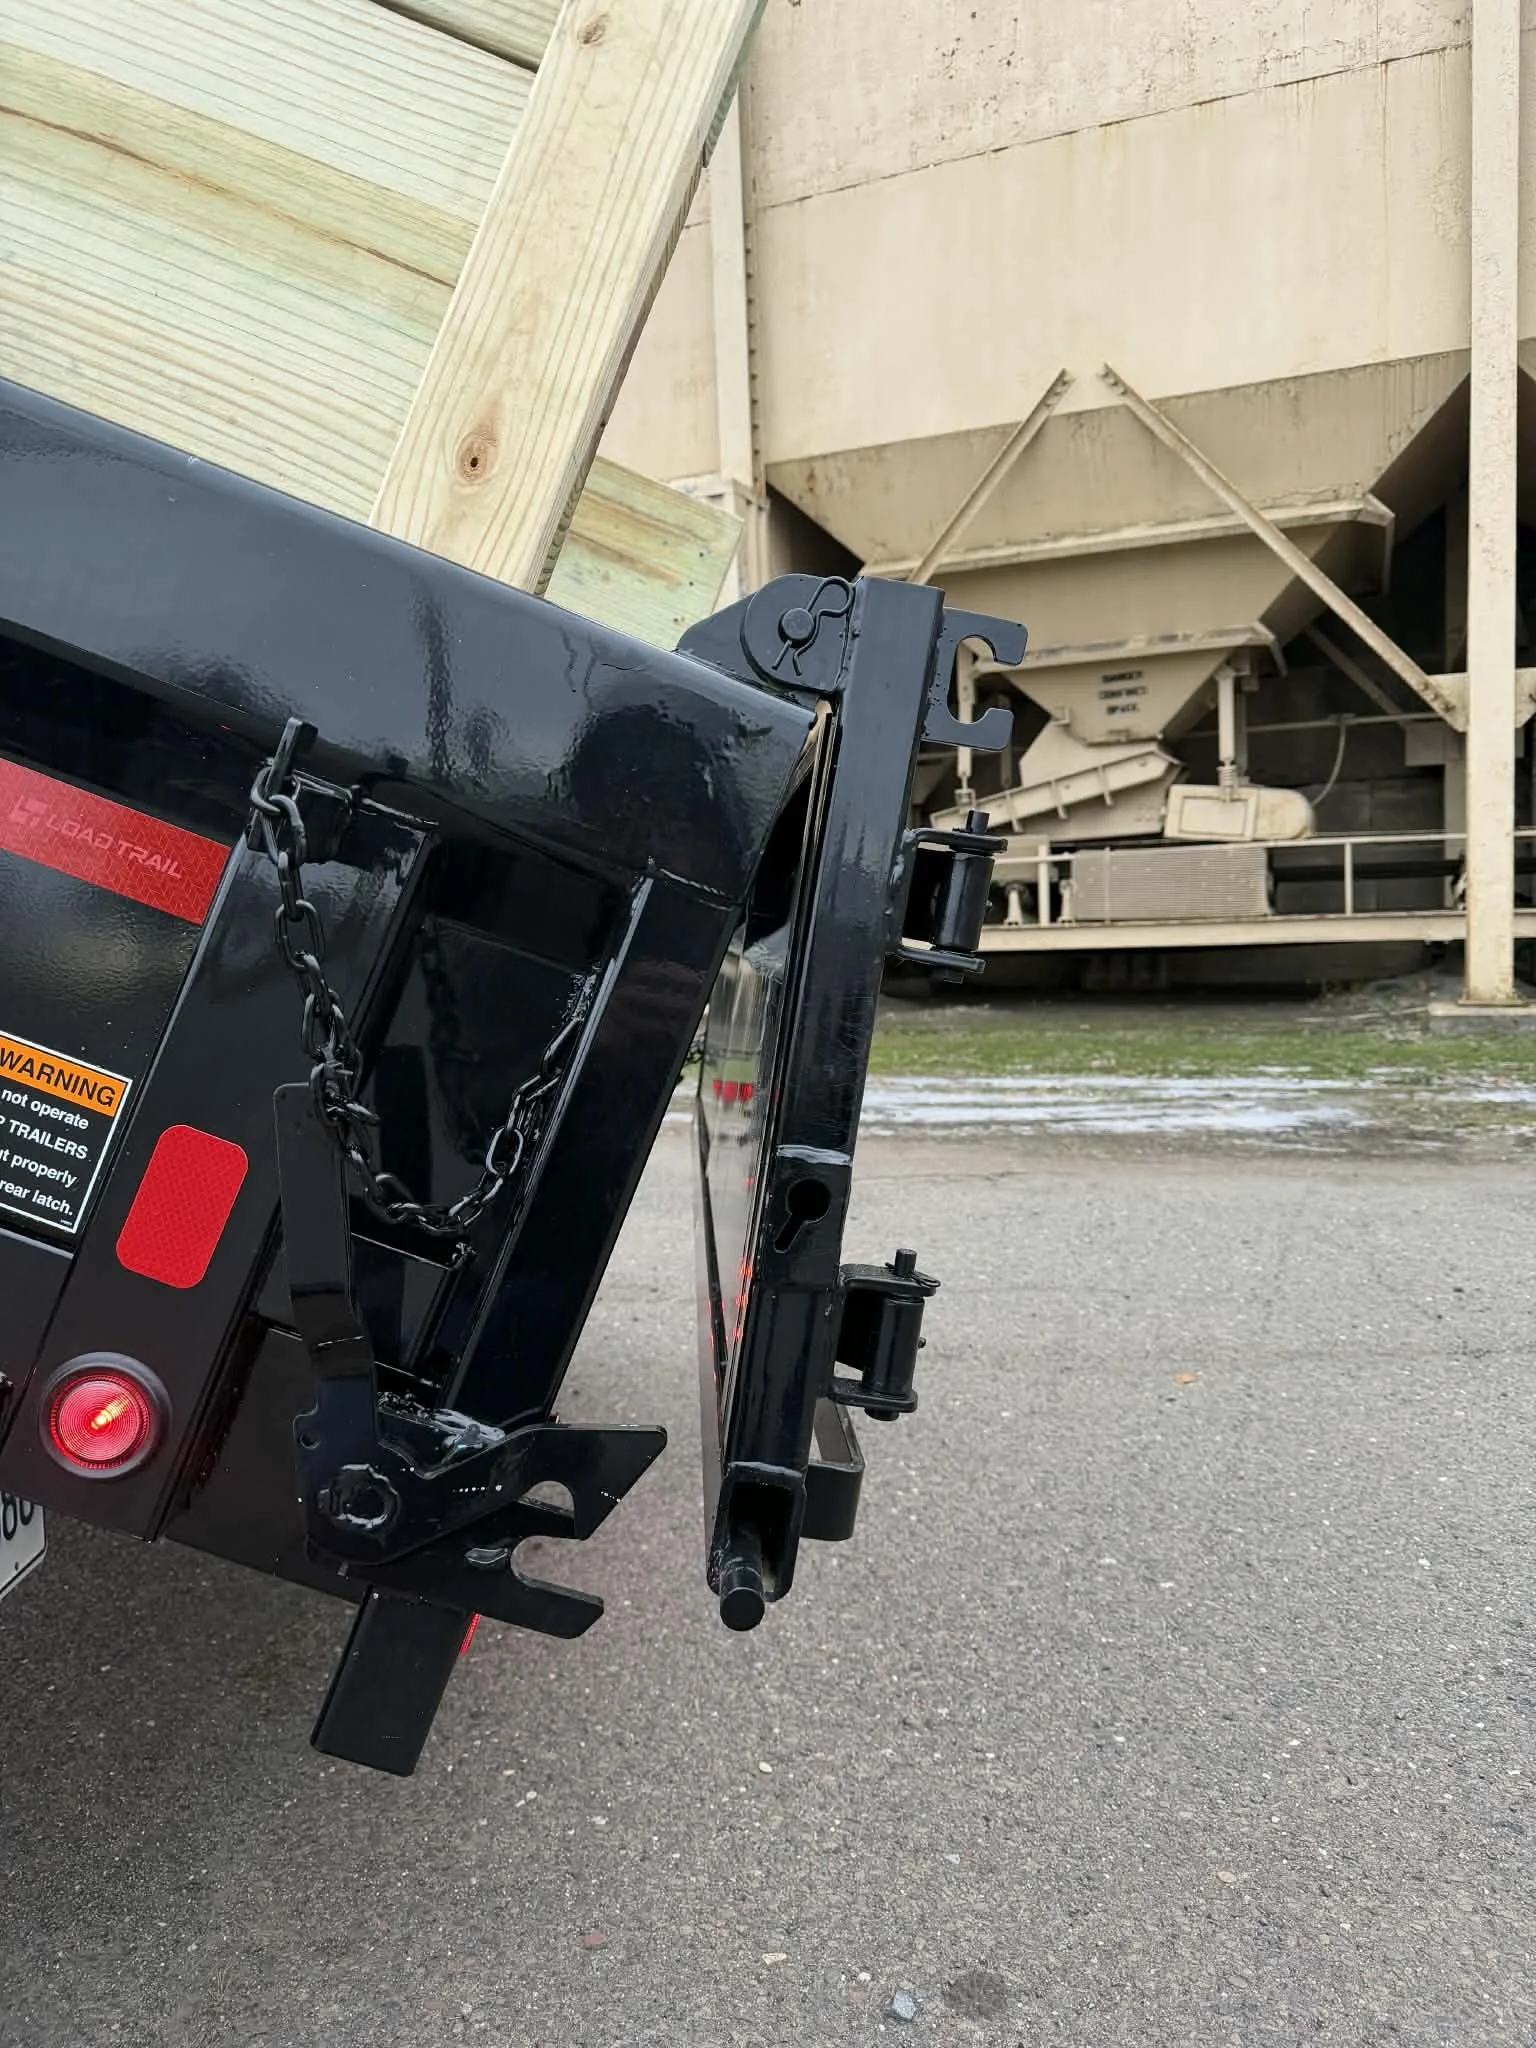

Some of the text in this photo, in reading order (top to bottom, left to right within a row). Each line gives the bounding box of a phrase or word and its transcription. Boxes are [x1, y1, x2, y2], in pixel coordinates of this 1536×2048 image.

[46, 814, 113, 850] LOAD
[116, 840, 183, 880] TRAIL
[0, 1047, 116, 1107] WARNING
[1, 1089, 28, 1107] not
[31, 1099, 89, 1130] operate
[9, 1120, 89, 1159] TRAILERS
[11, 1152, 78, 1188] properly
[0, 1179, 73, 1216] rear latch.
